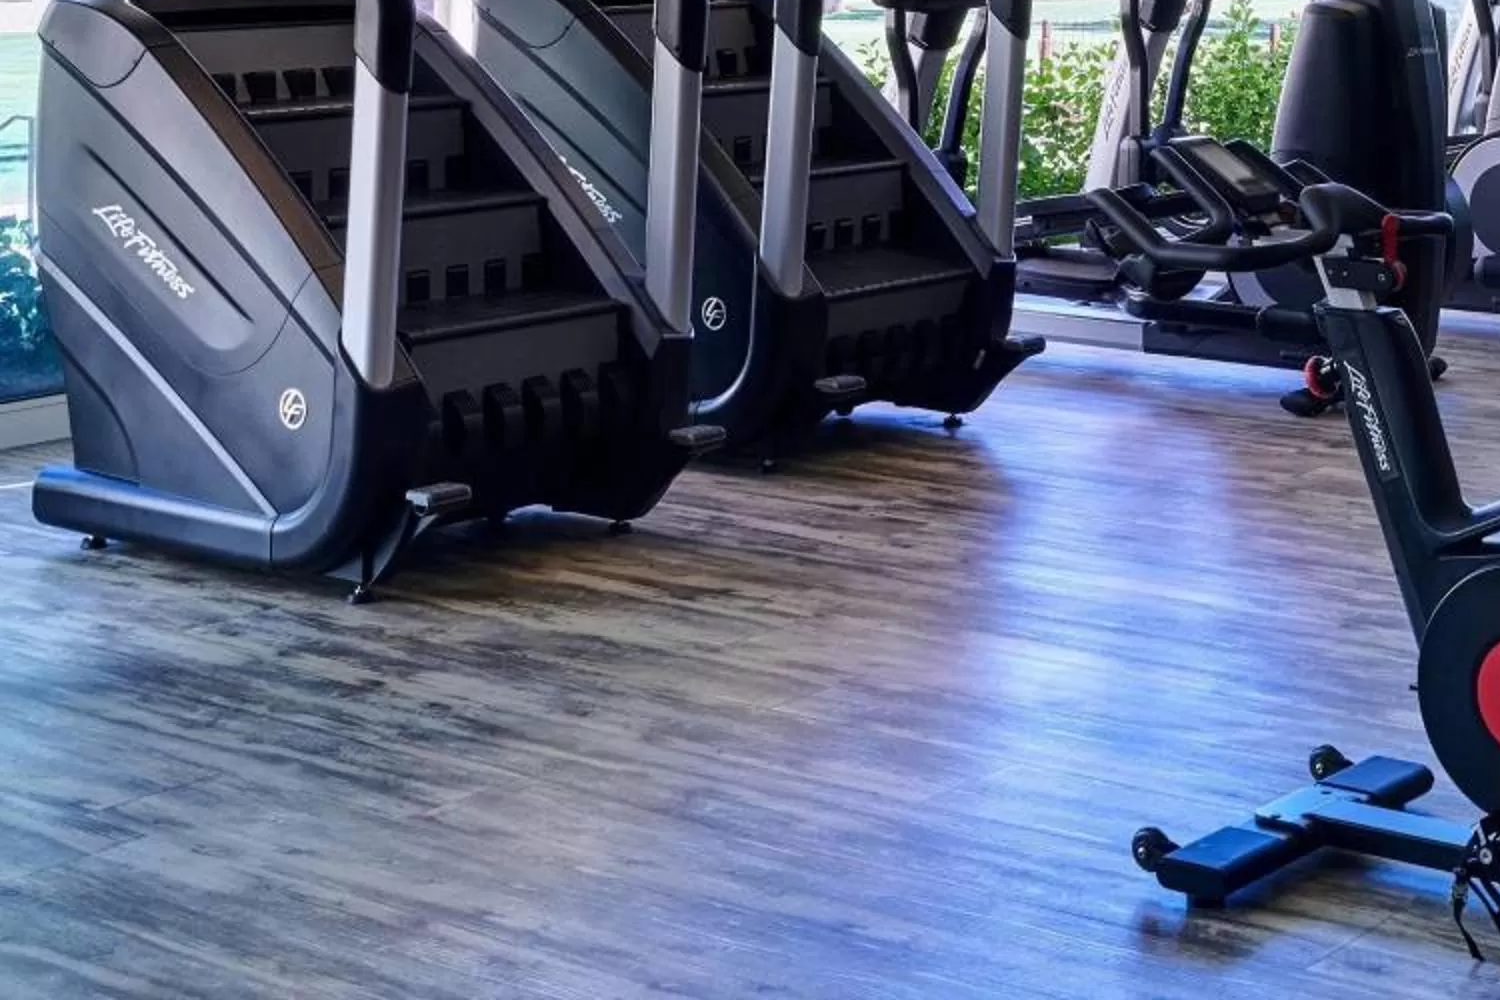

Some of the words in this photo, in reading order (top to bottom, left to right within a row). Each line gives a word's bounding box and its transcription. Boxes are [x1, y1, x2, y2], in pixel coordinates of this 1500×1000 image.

[91, 204, 136, 238] Life
[123, 229, 195, 299] Fitness
[1343, 360, 1371, 402] Life
[1355, 400, 1391, 472] Fitness
